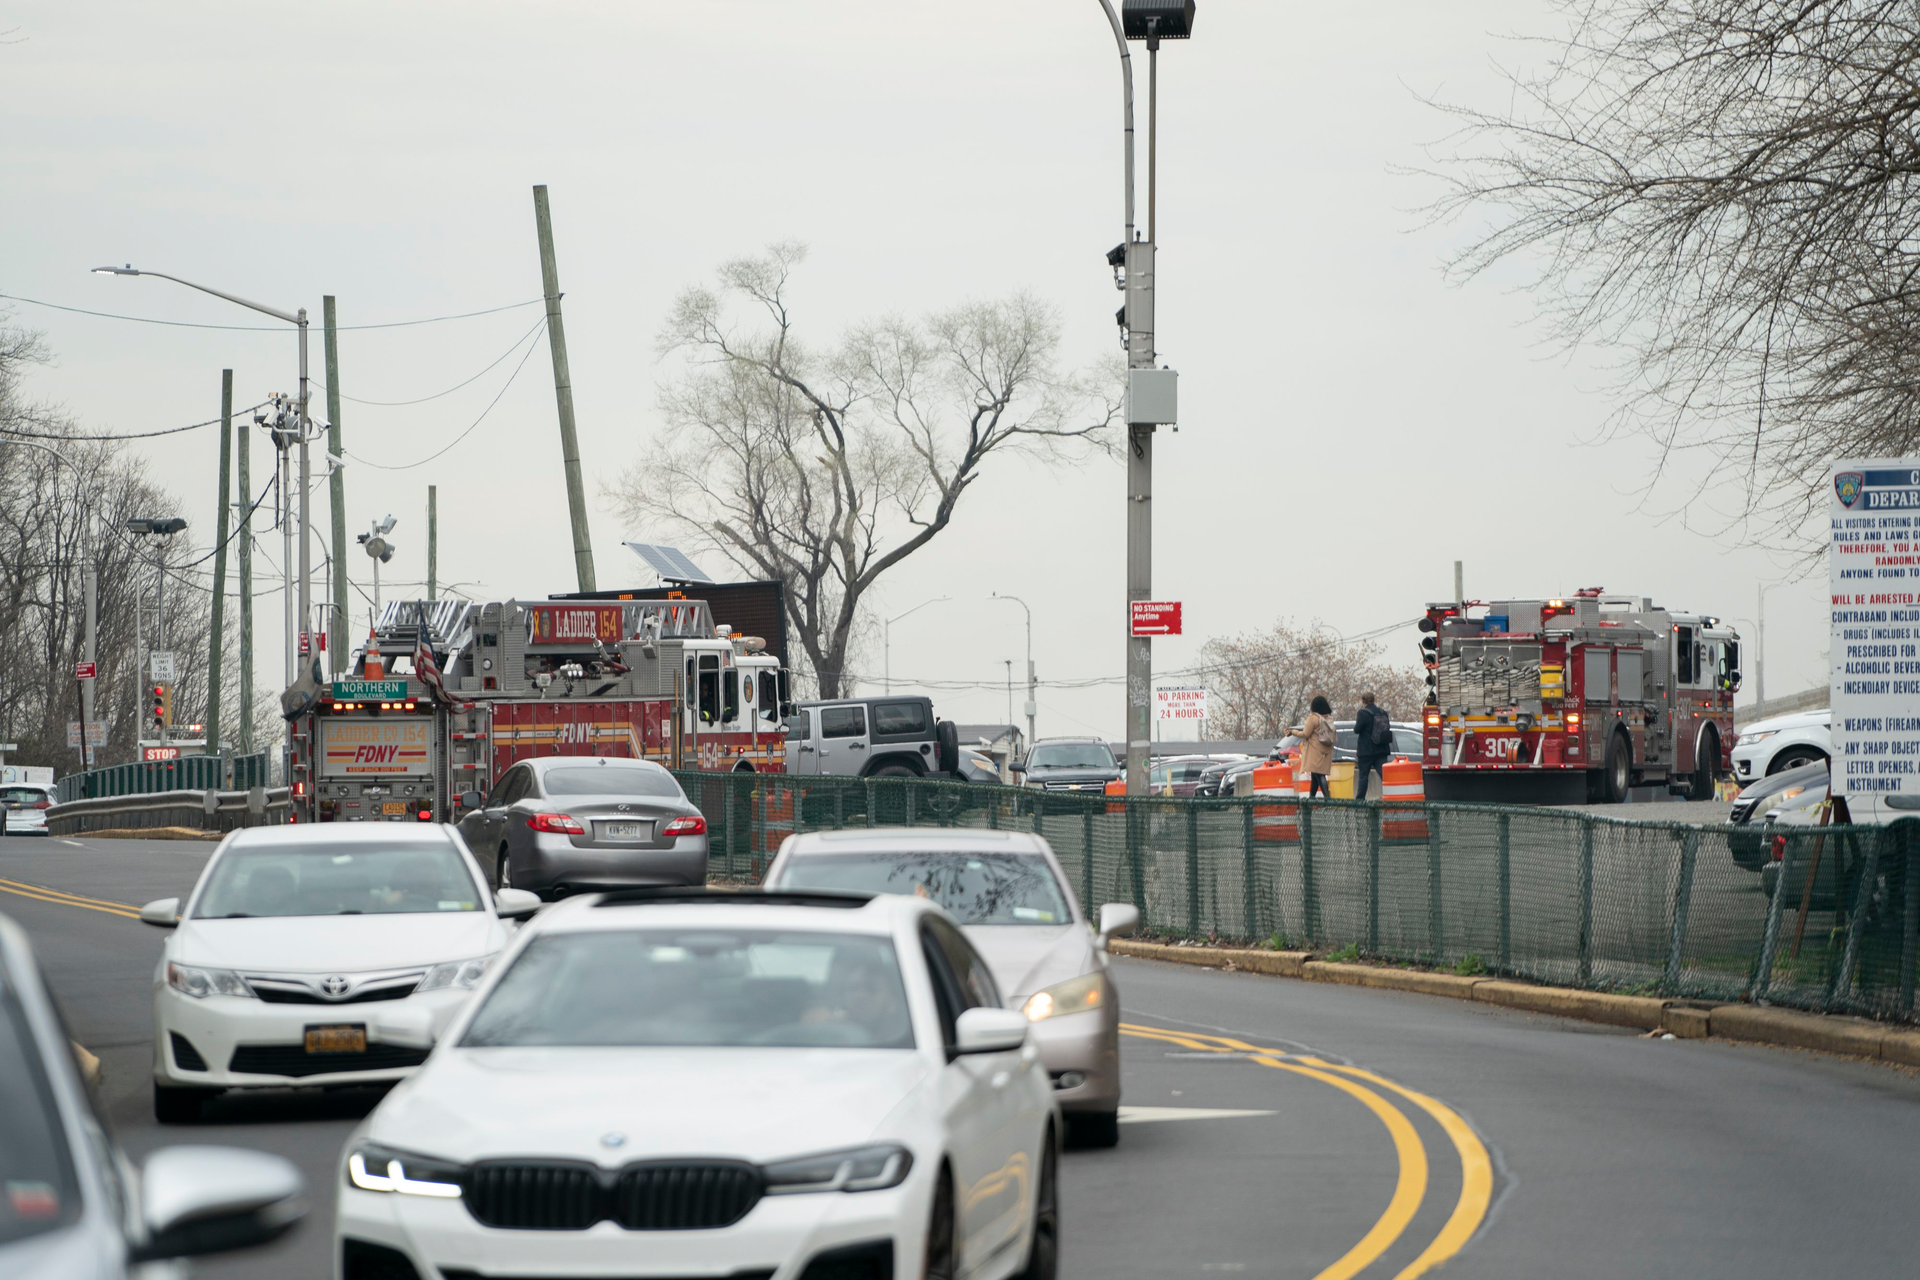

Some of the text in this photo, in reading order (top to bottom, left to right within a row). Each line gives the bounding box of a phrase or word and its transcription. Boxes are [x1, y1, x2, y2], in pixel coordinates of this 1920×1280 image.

[1869, 491, 1920, 508] DEPAR
[1832, 518, 1842, 529] ALL
[1846, 518, 1876, 528] VISITORS
[1878, 516, 1911, 528] ENTERING
[1834, 532, 1860, 541] RULES
[1864, 531, 1881, 540] AND
[1886, 530, 1909, 540] LAWS
[1838, 544, 1889, 554] THEREFORE,
[1893, 543, 1909, 553] YOU
[1840, 568, 1920, 579] ANYONE FOUND TO
[1832, 594, 1851, 605] WILL
[1855, 594, 1865, 604] BE
[1870, 593, 1914, 604] ARRESTED
[1134, 613, 1159, 622] Anytime
[1832, 610, 1920, 623] CONTRABAND INCLUD
[555, 610, 596, 638] LADDER
[600, 610, 617, 638] 154
[1844, 629, 1868, 640] DRUGS
[1871, 628, 1910, 640] (INCLUDES
[1848, 644, 1916, 658] PRESCRIBED FOR
[1845, 661, 1890, 674] ALCOHOLIC
[341, 682, 399, 693] NORTHERN
[1844, 681, 1920, 694] INCENDIARY DEVICE
[1158, 691, 1204, 701] NO PARKING
[1160, 709, 1204, 718] 24 HOURS
[1844, 718, 1882, 731] WEAPONS
[326, 726, 380, 742] LADDER
[403, 725, 426, 742] 154
[562, 722, 592, 744] FDNY
[147, 749, 177, 760] STOP
[355, 745, 399, 763] FDNY
[1845, 741, 1920, 755] ANY SHARP OBJECT
[703, 742, 718, 768] 154
[1846, 761, 1916, 775] LETTER OPENERS,
[1847, 778, 1902, 791] INSTRUMENT
